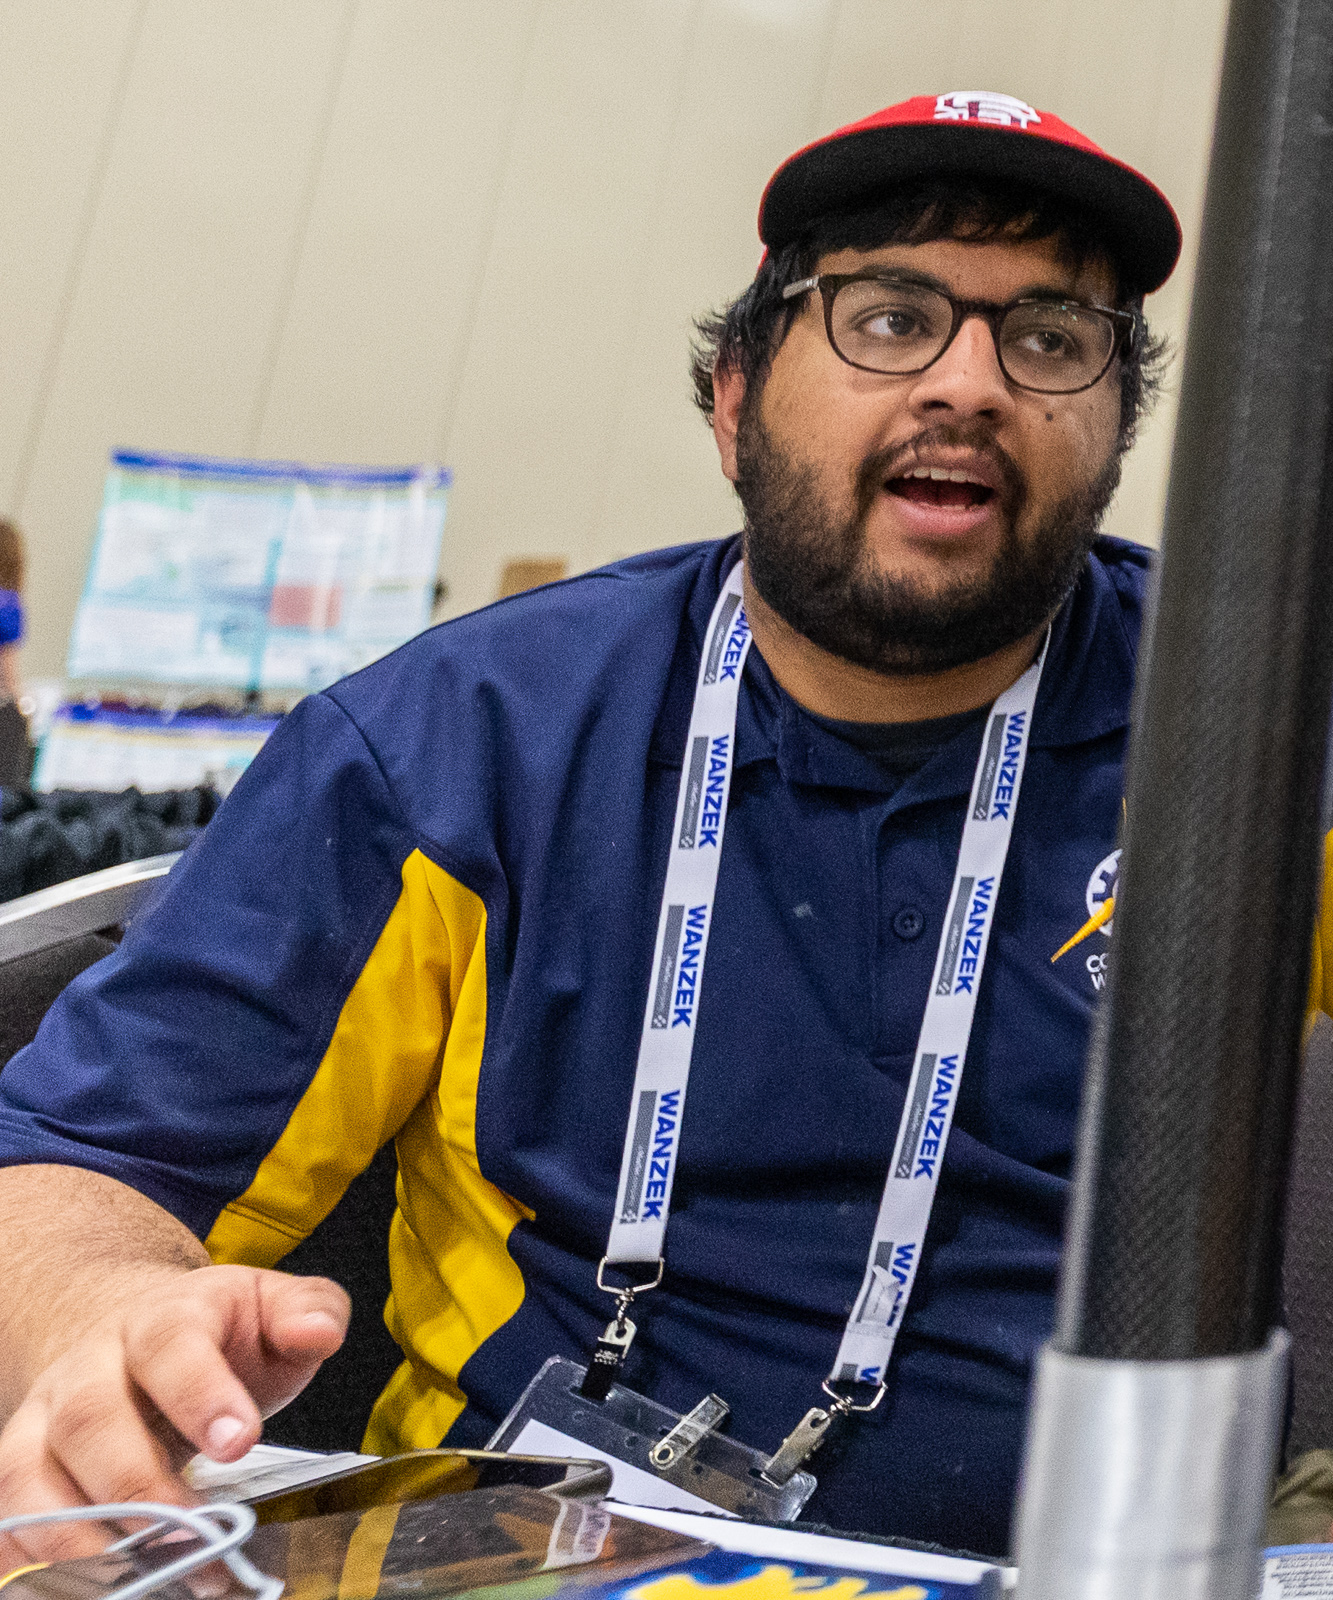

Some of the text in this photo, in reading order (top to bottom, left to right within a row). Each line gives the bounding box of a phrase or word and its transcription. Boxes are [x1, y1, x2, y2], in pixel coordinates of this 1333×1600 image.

[720, 606, 751, 683] ANZEK
[698, 734, 730, 849] WANZEK
[991, 711, 1027, 822] WANZEK
[671, 904, 708, 1029] WANZEK
[954, 876, 996, 996] WANZEK
[640, 1089, 681, 1222] WANZEK
[914, 1054, 958, 1180] WANZEK
